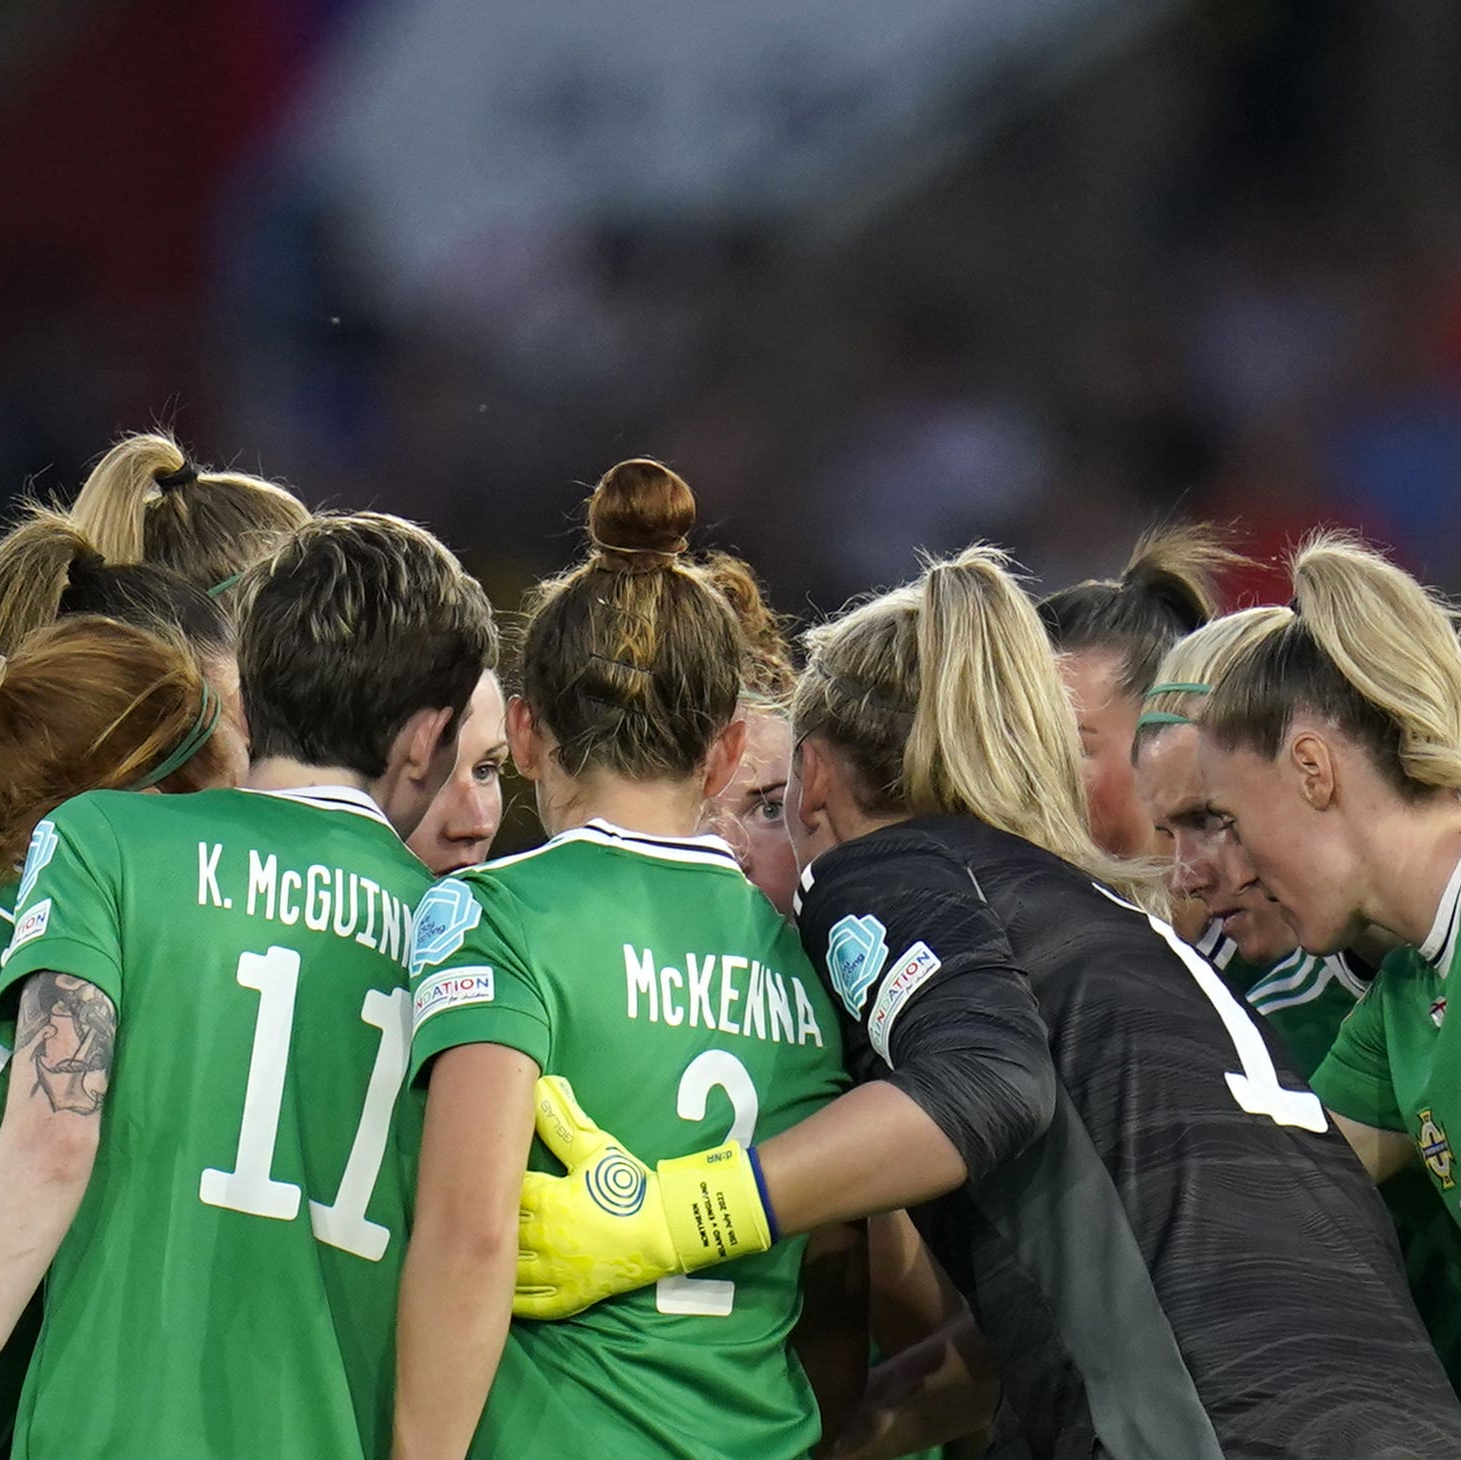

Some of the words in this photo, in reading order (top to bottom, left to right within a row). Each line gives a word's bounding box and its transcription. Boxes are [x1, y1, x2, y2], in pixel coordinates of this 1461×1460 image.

[198, 841, 232, 909] K.
[623, 943, 824, 1048] McKENNA
[199, 945, 411, 1262] 11
[655, 1048, 759, 1316] 2
